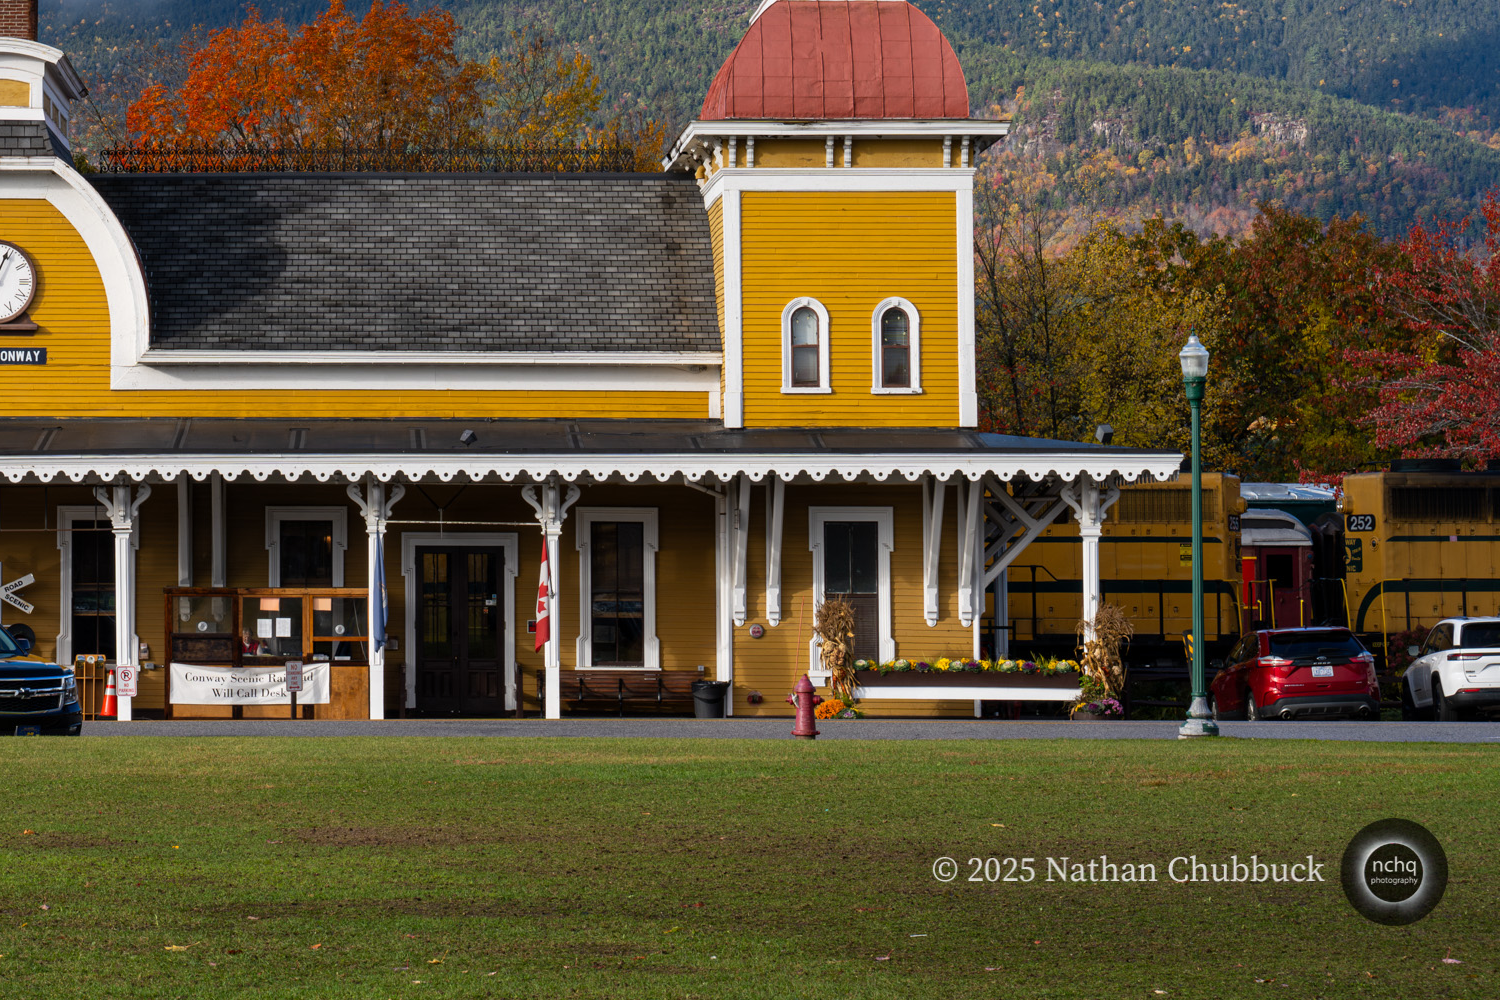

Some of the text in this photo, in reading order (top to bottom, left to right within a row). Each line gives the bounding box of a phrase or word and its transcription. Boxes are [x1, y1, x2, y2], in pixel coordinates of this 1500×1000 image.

[1350, 515, 1372, 531] 252
[4, 580, 24, 593] ROAD
[4, 593, 30, 611] SCENIC
[185, 672, 228, 685] Conway
[230, 673, 264, 683] Scenic
[212, 687, 287, 698] Will Call Desk
